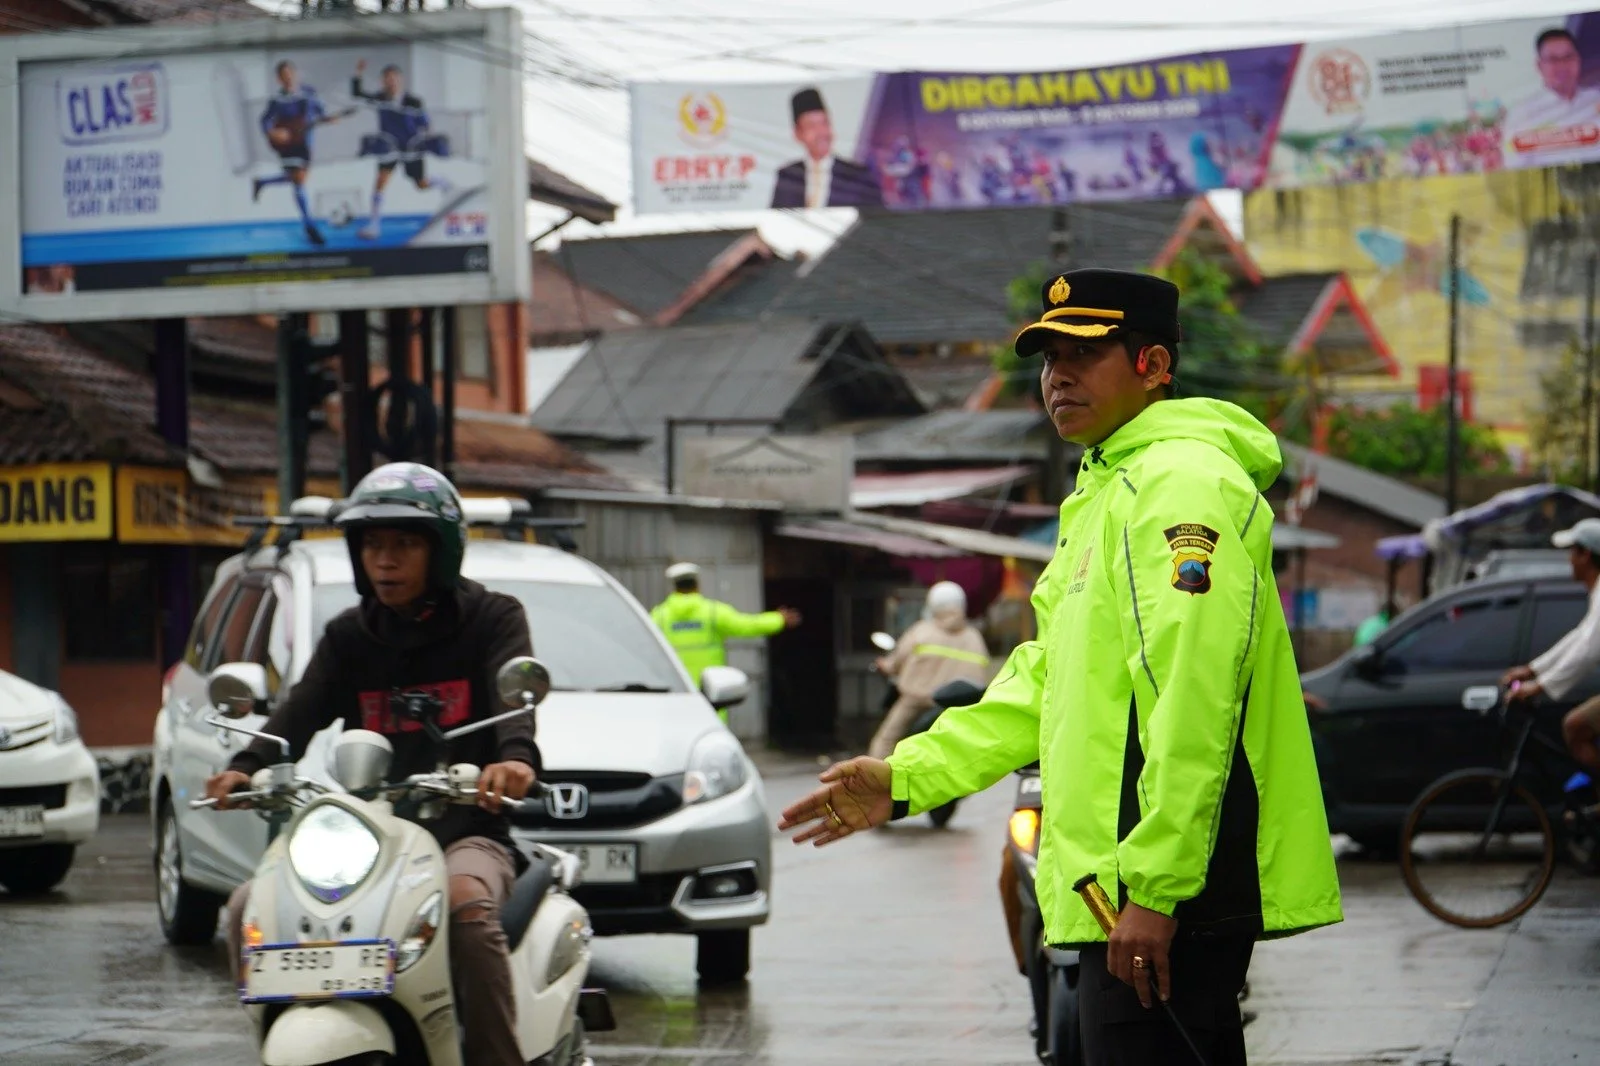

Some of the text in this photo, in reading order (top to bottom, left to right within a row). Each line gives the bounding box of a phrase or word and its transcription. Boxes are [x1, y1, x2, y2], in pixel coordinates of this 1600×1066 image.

[920, 59, 1230, 112] DIRGAHAYU TNI
[69, 79, 133, 134] CLAS
[1173, 539, 1213, 552] JAWA TENGAH
[606, 848, 634, 871] RK
[251, 951, 265, 973] Z
